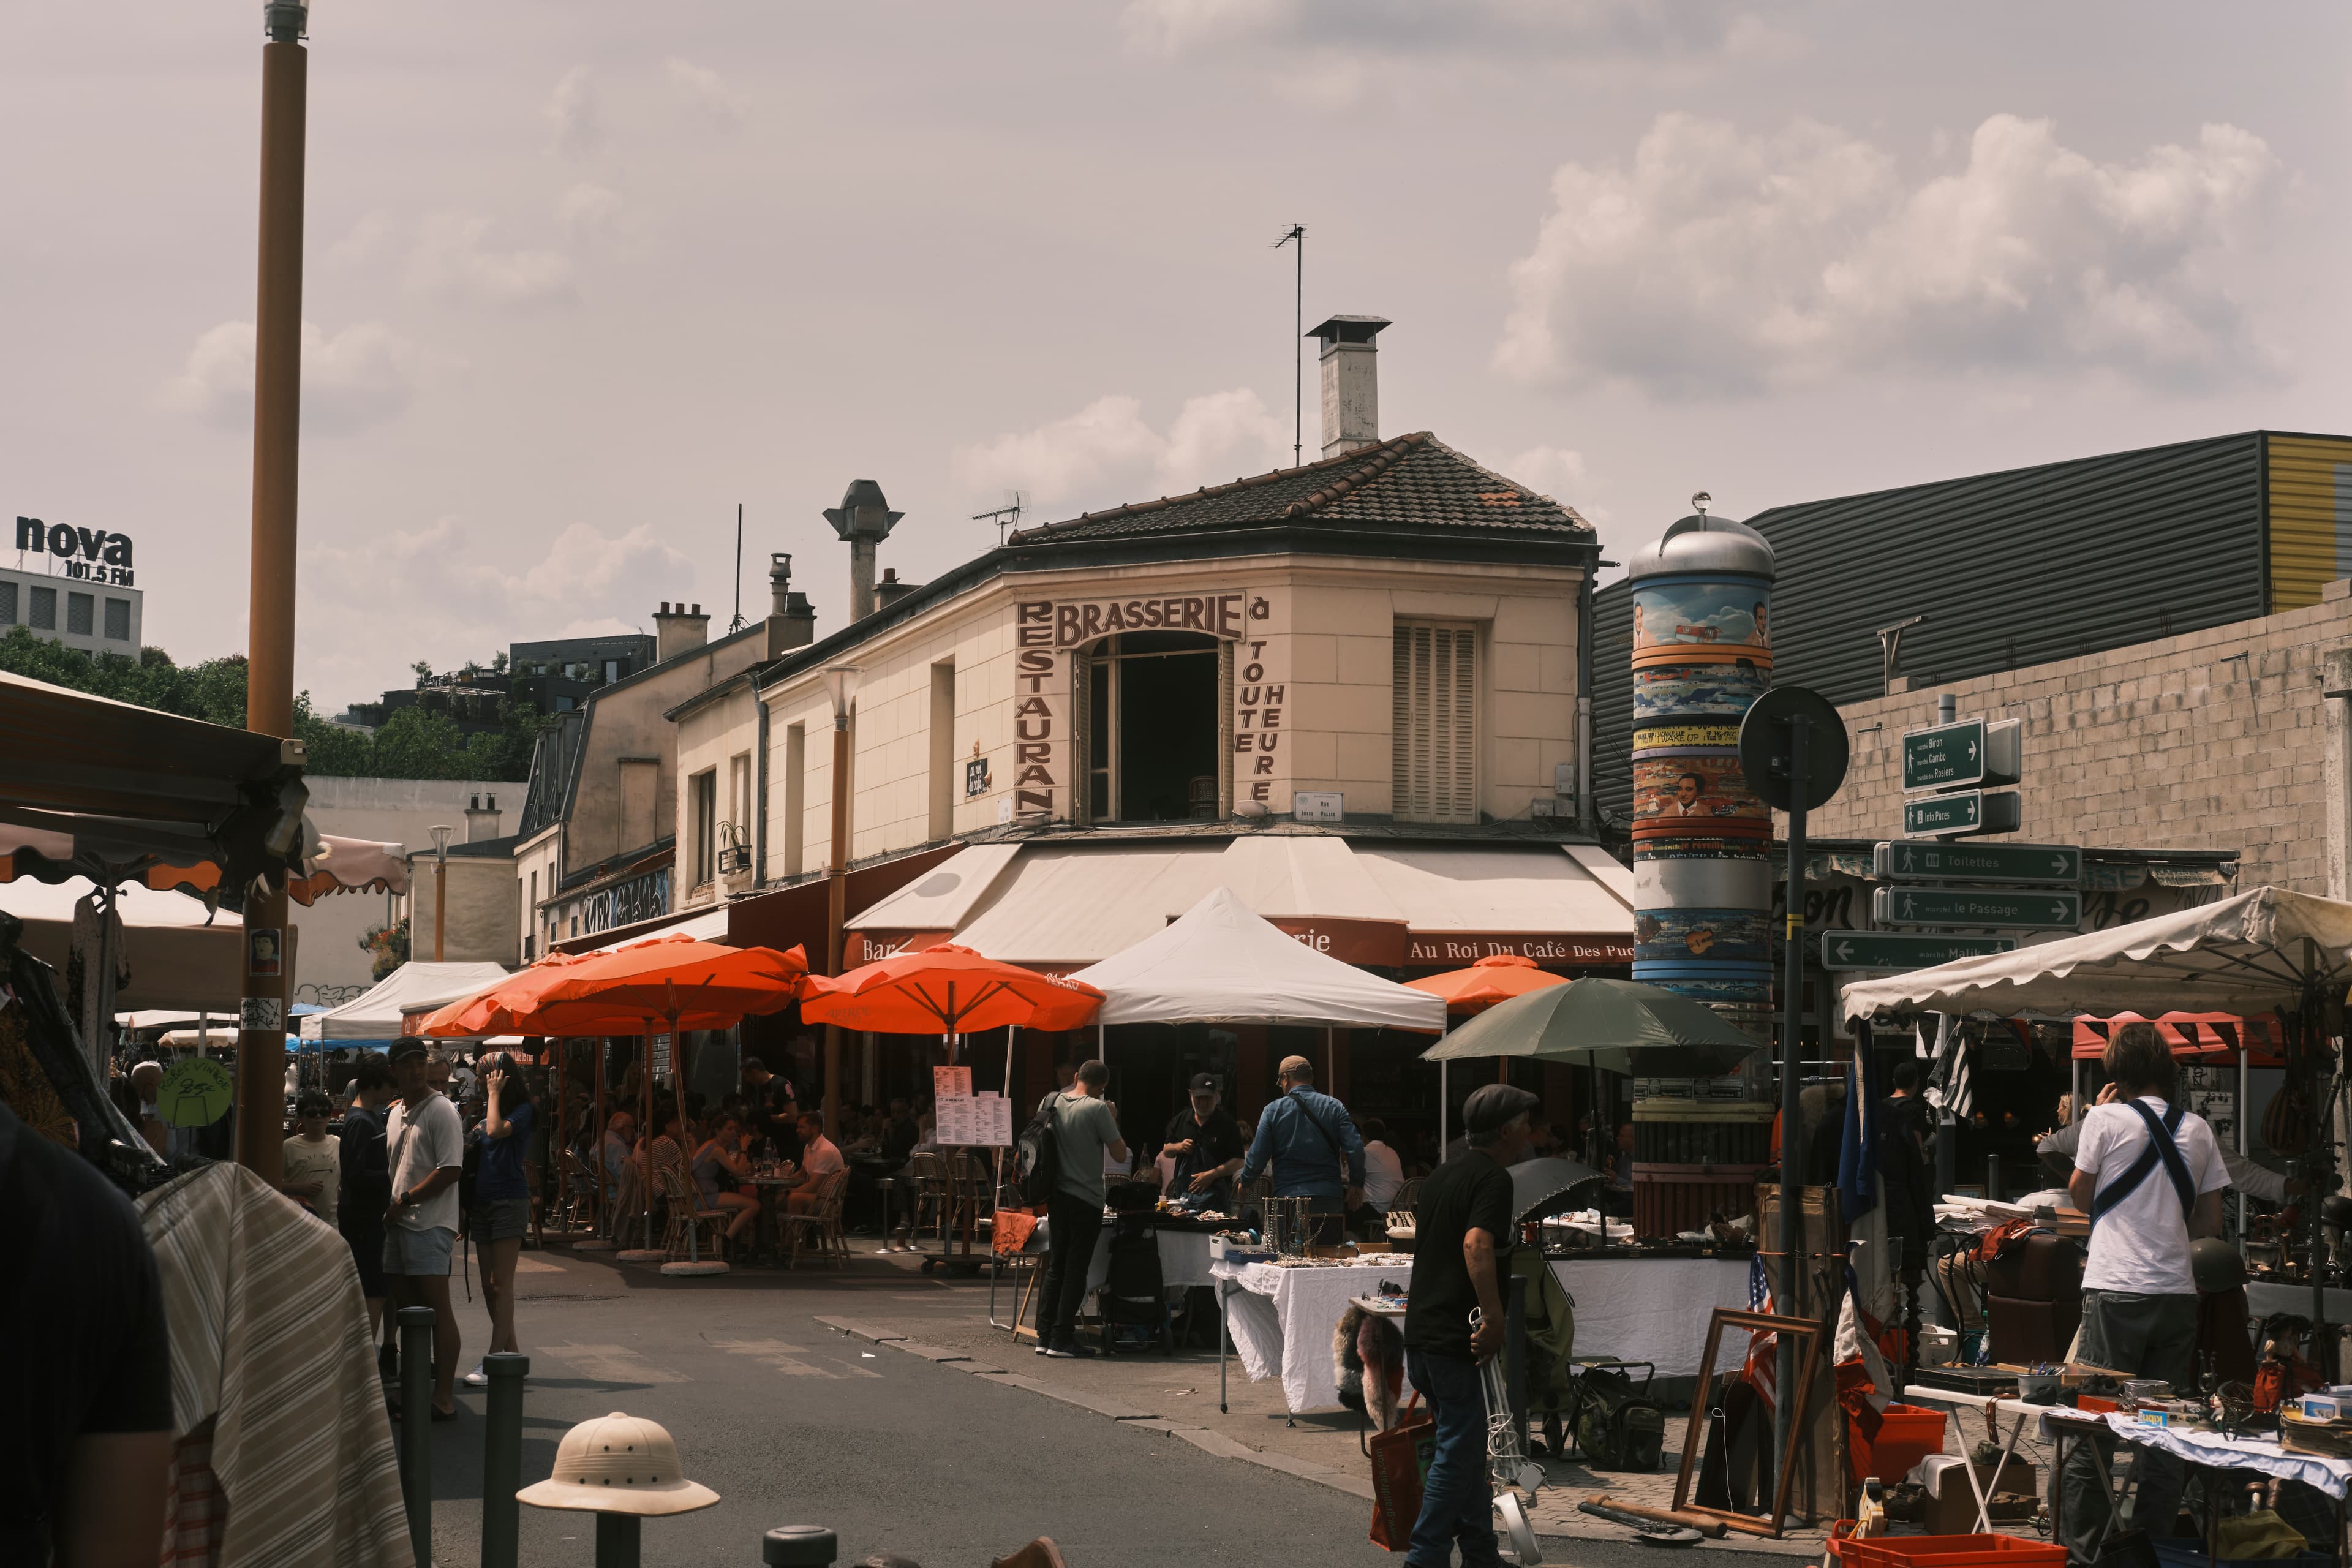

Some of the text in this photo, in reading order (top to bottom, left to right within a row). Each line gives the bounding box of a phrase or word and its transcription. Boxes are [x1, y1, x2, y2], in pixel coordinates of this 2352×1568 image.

[16, 516, 133, 568] nova
[66, 560, 134, 587] 101.5 FM
[1056, 595, 1243, 647] BRASSERIE
[1234, 596, 1284, 801] à TOUTE HEURE
[1014, 601, 1055, 815] RESTAURAN
[1929, 738, 1943, 748] Biron
[1929, 752, 1946, 763] Cambo
[1934, 767, 1954, 778] Rosiers
[1924, 811, 1950, 822] Info Puces
[1948, 856, 1999, 868] Toilettes
[1954, 902, 1965, 913] le
[1969, 903, 2018, 917] Passage
[862, 940, 895, 961] Bar
[1411, 942, 1438, 959] Au
[1447, 941, 1479, 959] Roi
[1487, 942, 1514, 957] Du
[1523, 941, 1566, 959] Café
[1574, 945, 1600, 957] Des
[1918, 947, 1980, 959] marché Malik
